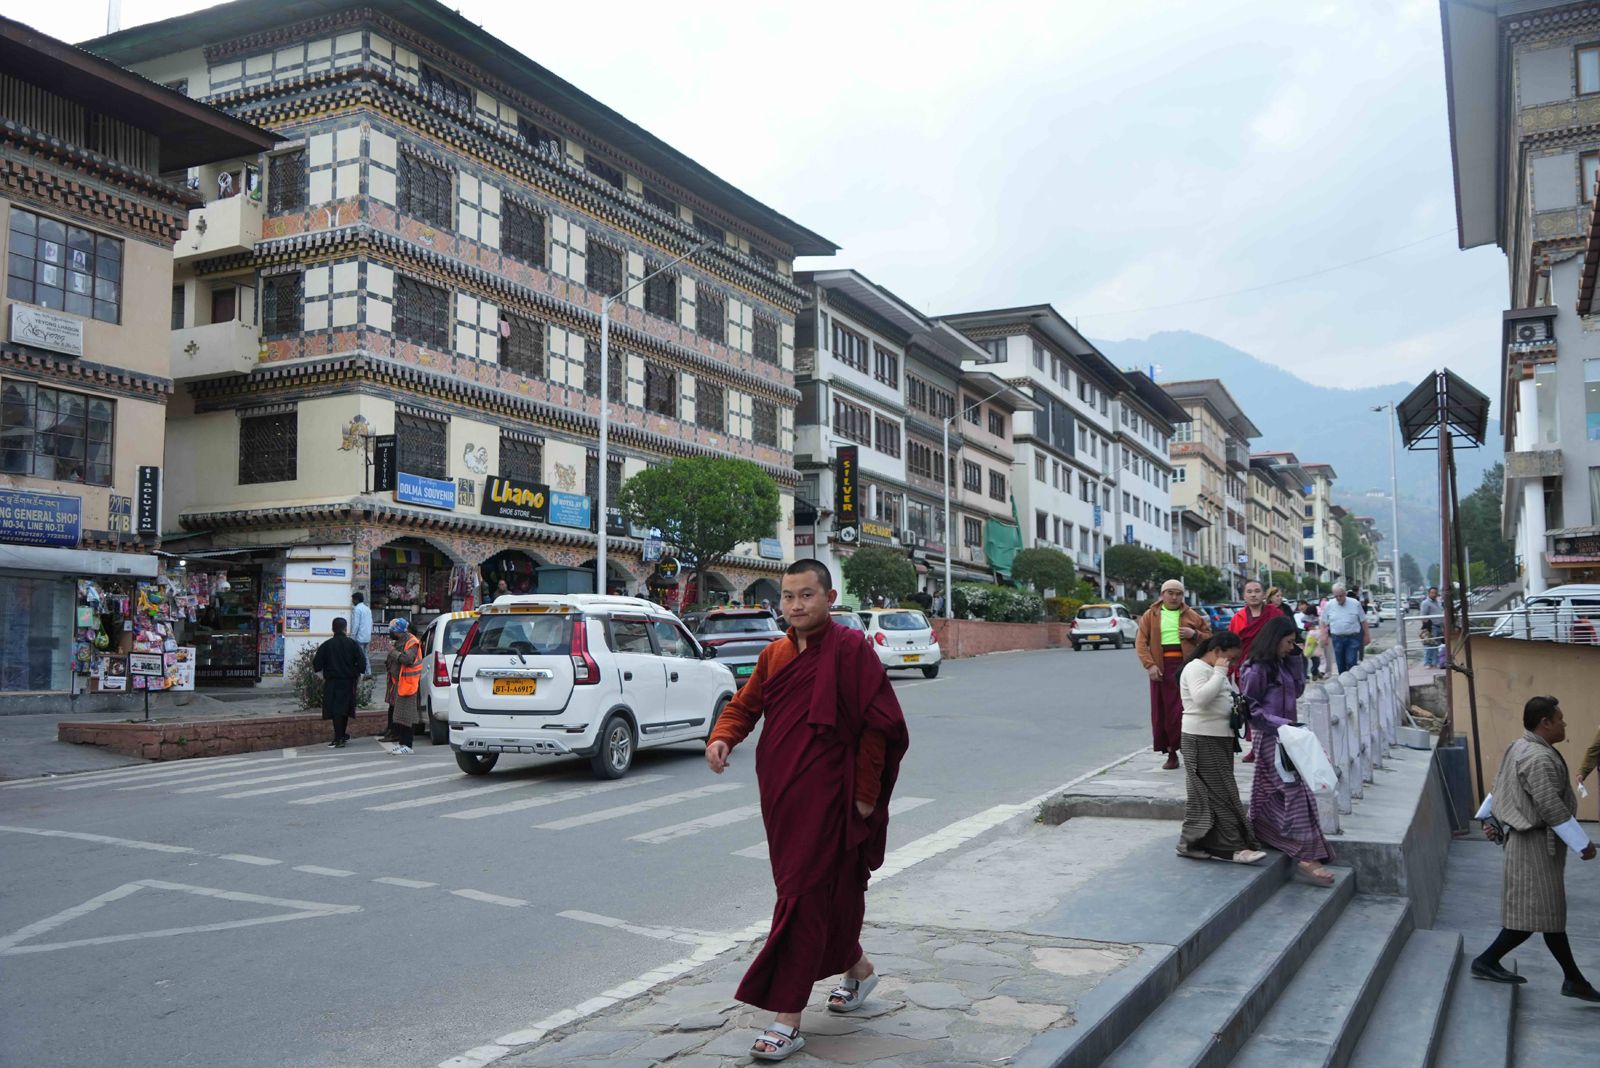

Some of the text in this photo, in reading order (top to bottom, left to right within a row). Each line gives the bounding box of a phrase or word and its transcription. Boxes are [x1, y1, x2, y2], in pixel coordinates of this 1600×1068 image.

[399, 482, 423, 497] DOLMA
[423, 487, 455, 502] SOUVENIR
[491, 478, 545, 509] Lhamo
[842, 460, 853, 511] SILVER
[142, 482, 153, 529] SOLUTION
[500, 507, 514, 515] SHOE
[514, 509, 530, 517] STORE
[14, 508, 55, 522] GENERAL
[56, 511, 78, 524] SHOP
[27, 521, 44, 531] LINE
